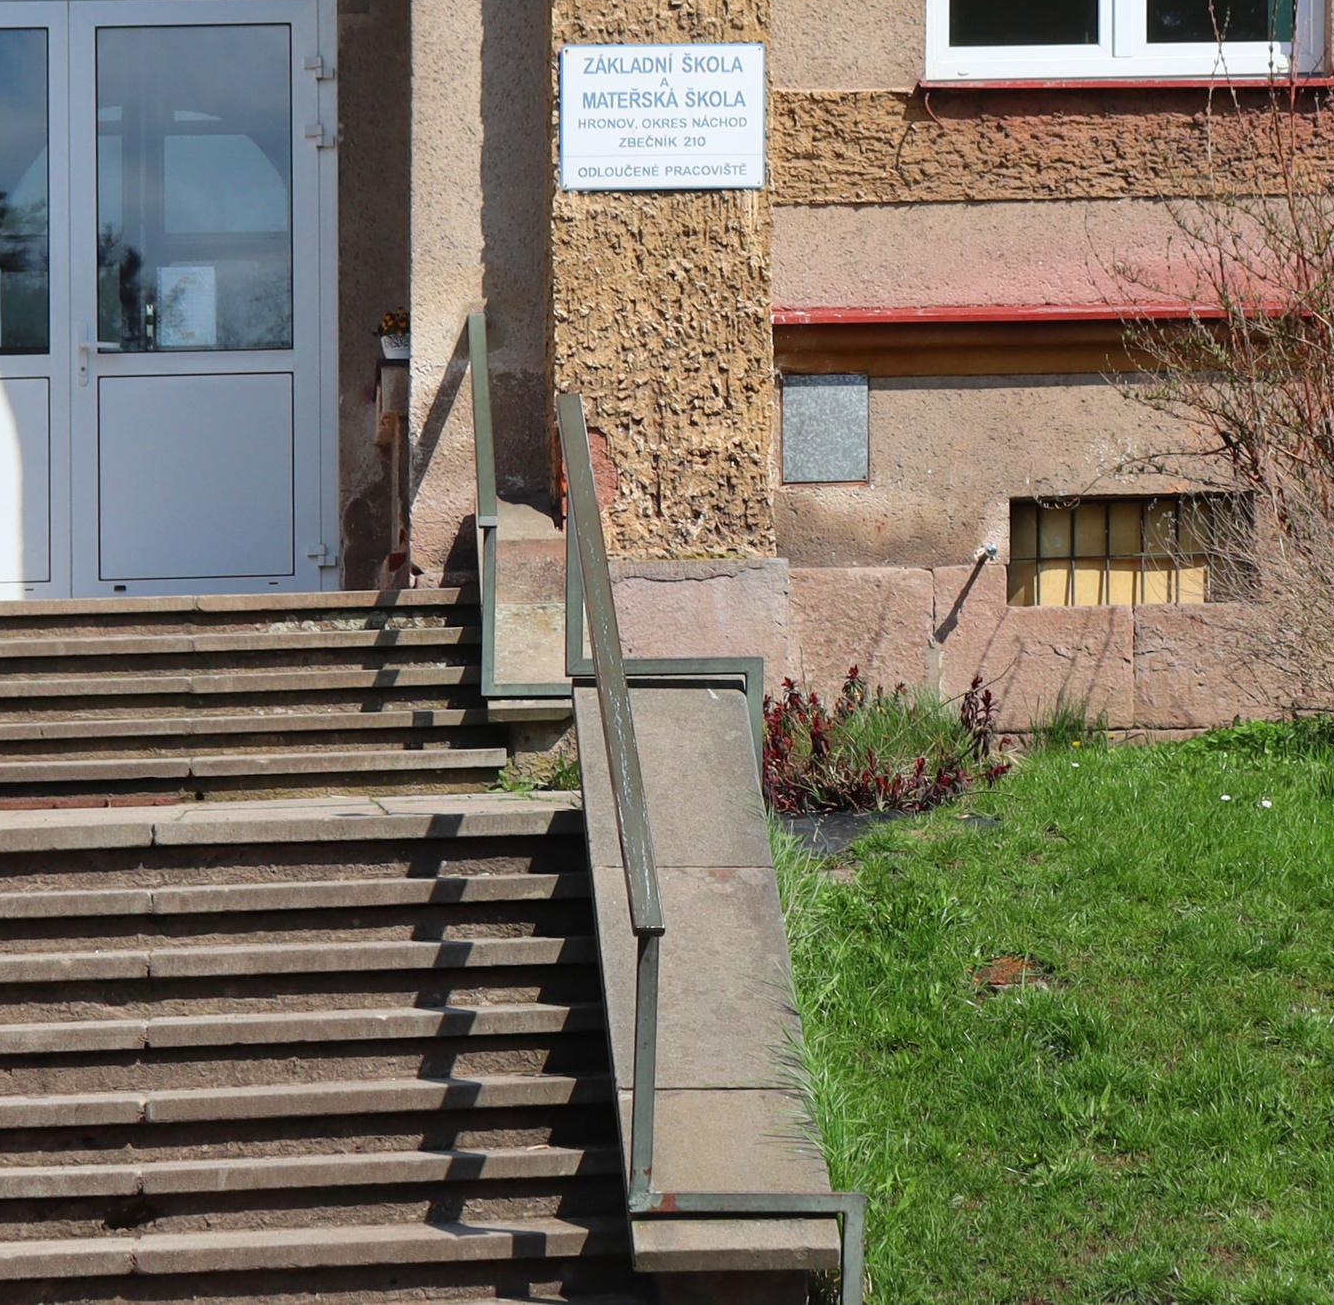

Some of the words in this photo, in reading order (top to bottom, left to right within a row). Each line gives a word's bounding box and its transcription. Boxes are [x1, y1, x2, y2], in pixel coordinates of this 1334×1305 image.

[583, 53, 673, 74] ZÁKLADNÍ
[682, 53, 743, 73] ŠKOLA
[659, 77, 669, 87] A
[583, 88, 678, 109] MATEŘSKÁ
[685, 88, 746, 108] ŠKOLA
[578, 118, 638, 130] HRONOV,
[642, 118, 687, 129] OKRES
[692, 115, 747, 128] NÁCHOD
[619, 135, 677, 148] ZBEČNÍK
[684, 136, 706, 147] 210
[578, 164, 659, 178] ODLOUČENÉ
[665, 163, 747, 176] PRACOVIŠTĚ
